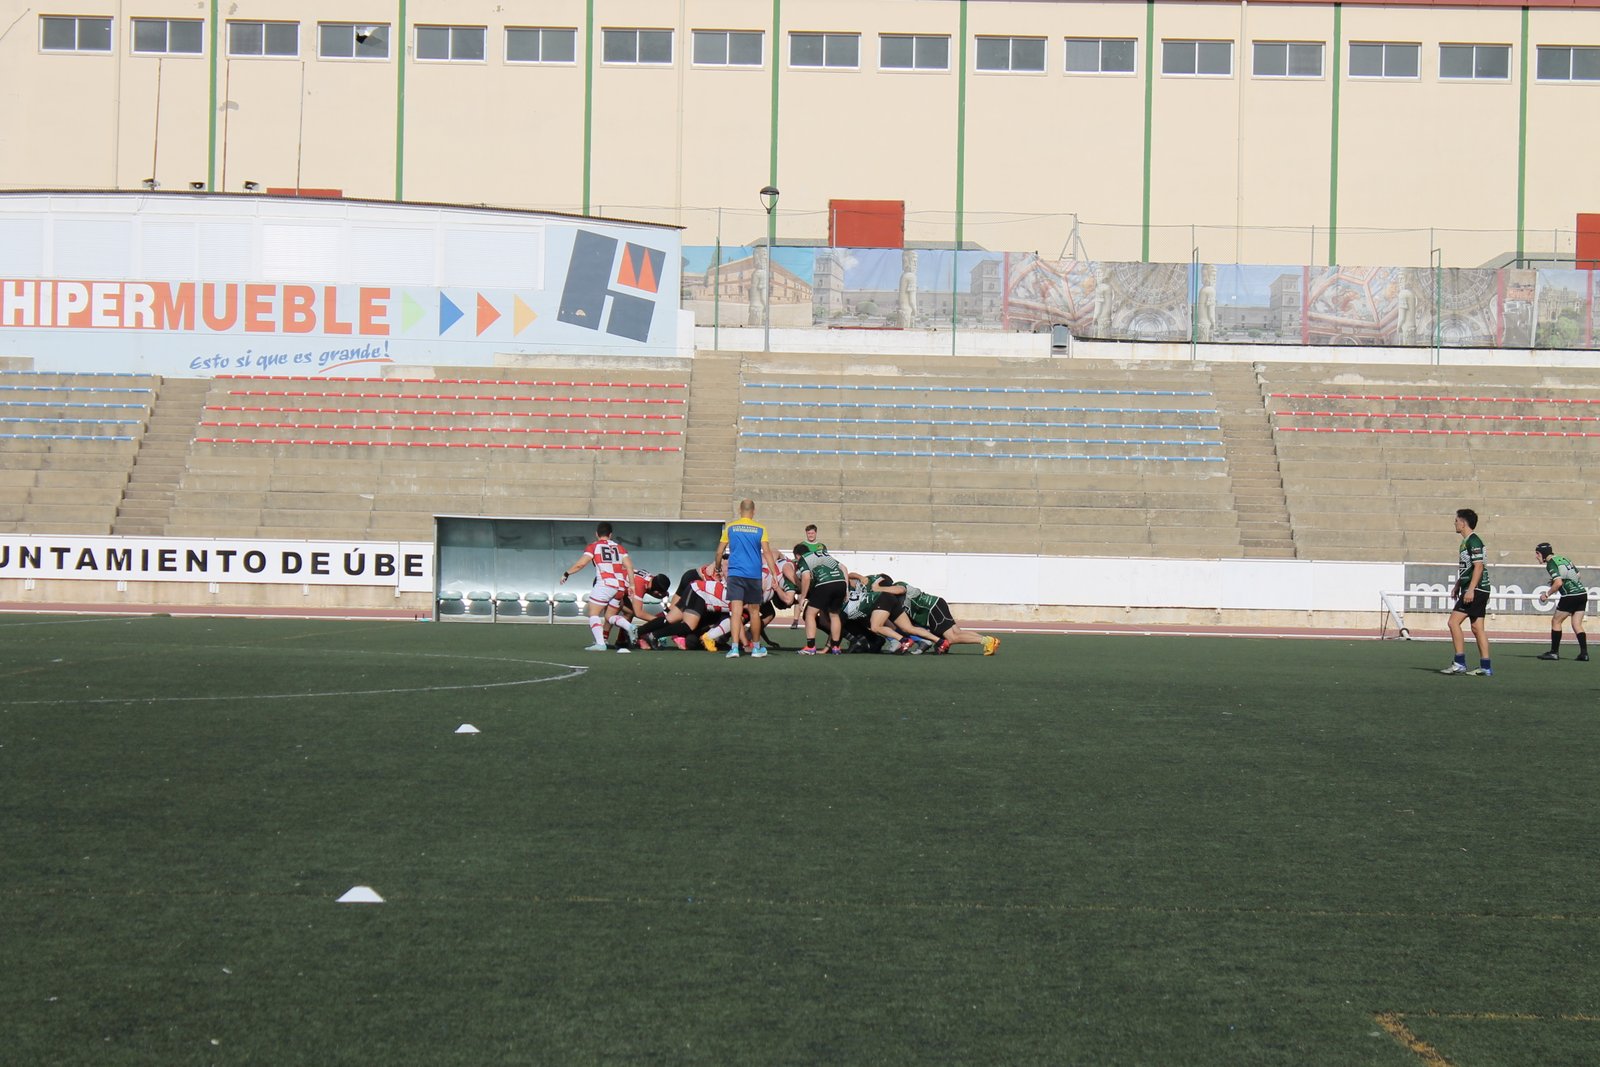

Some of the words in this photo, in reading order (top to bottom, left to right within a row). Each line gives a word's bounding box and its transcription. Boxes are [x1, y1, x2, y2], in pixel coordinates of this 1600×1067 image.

[2, 280, 391, 335] HIPERMUEBLE
[189, 353, 230, 370] Esto
[235, 349, 252, 368] si
[256, 353, 288, 371] que
[293, 351, 313, 364] es
[318, 340, 390, 366] grande!
[281, 551, 330, 575] DE
[343, 547, 434, 577] ÚBE
[601, 546, 620, 561] 61
[1409, 570, 1523, 611] min
